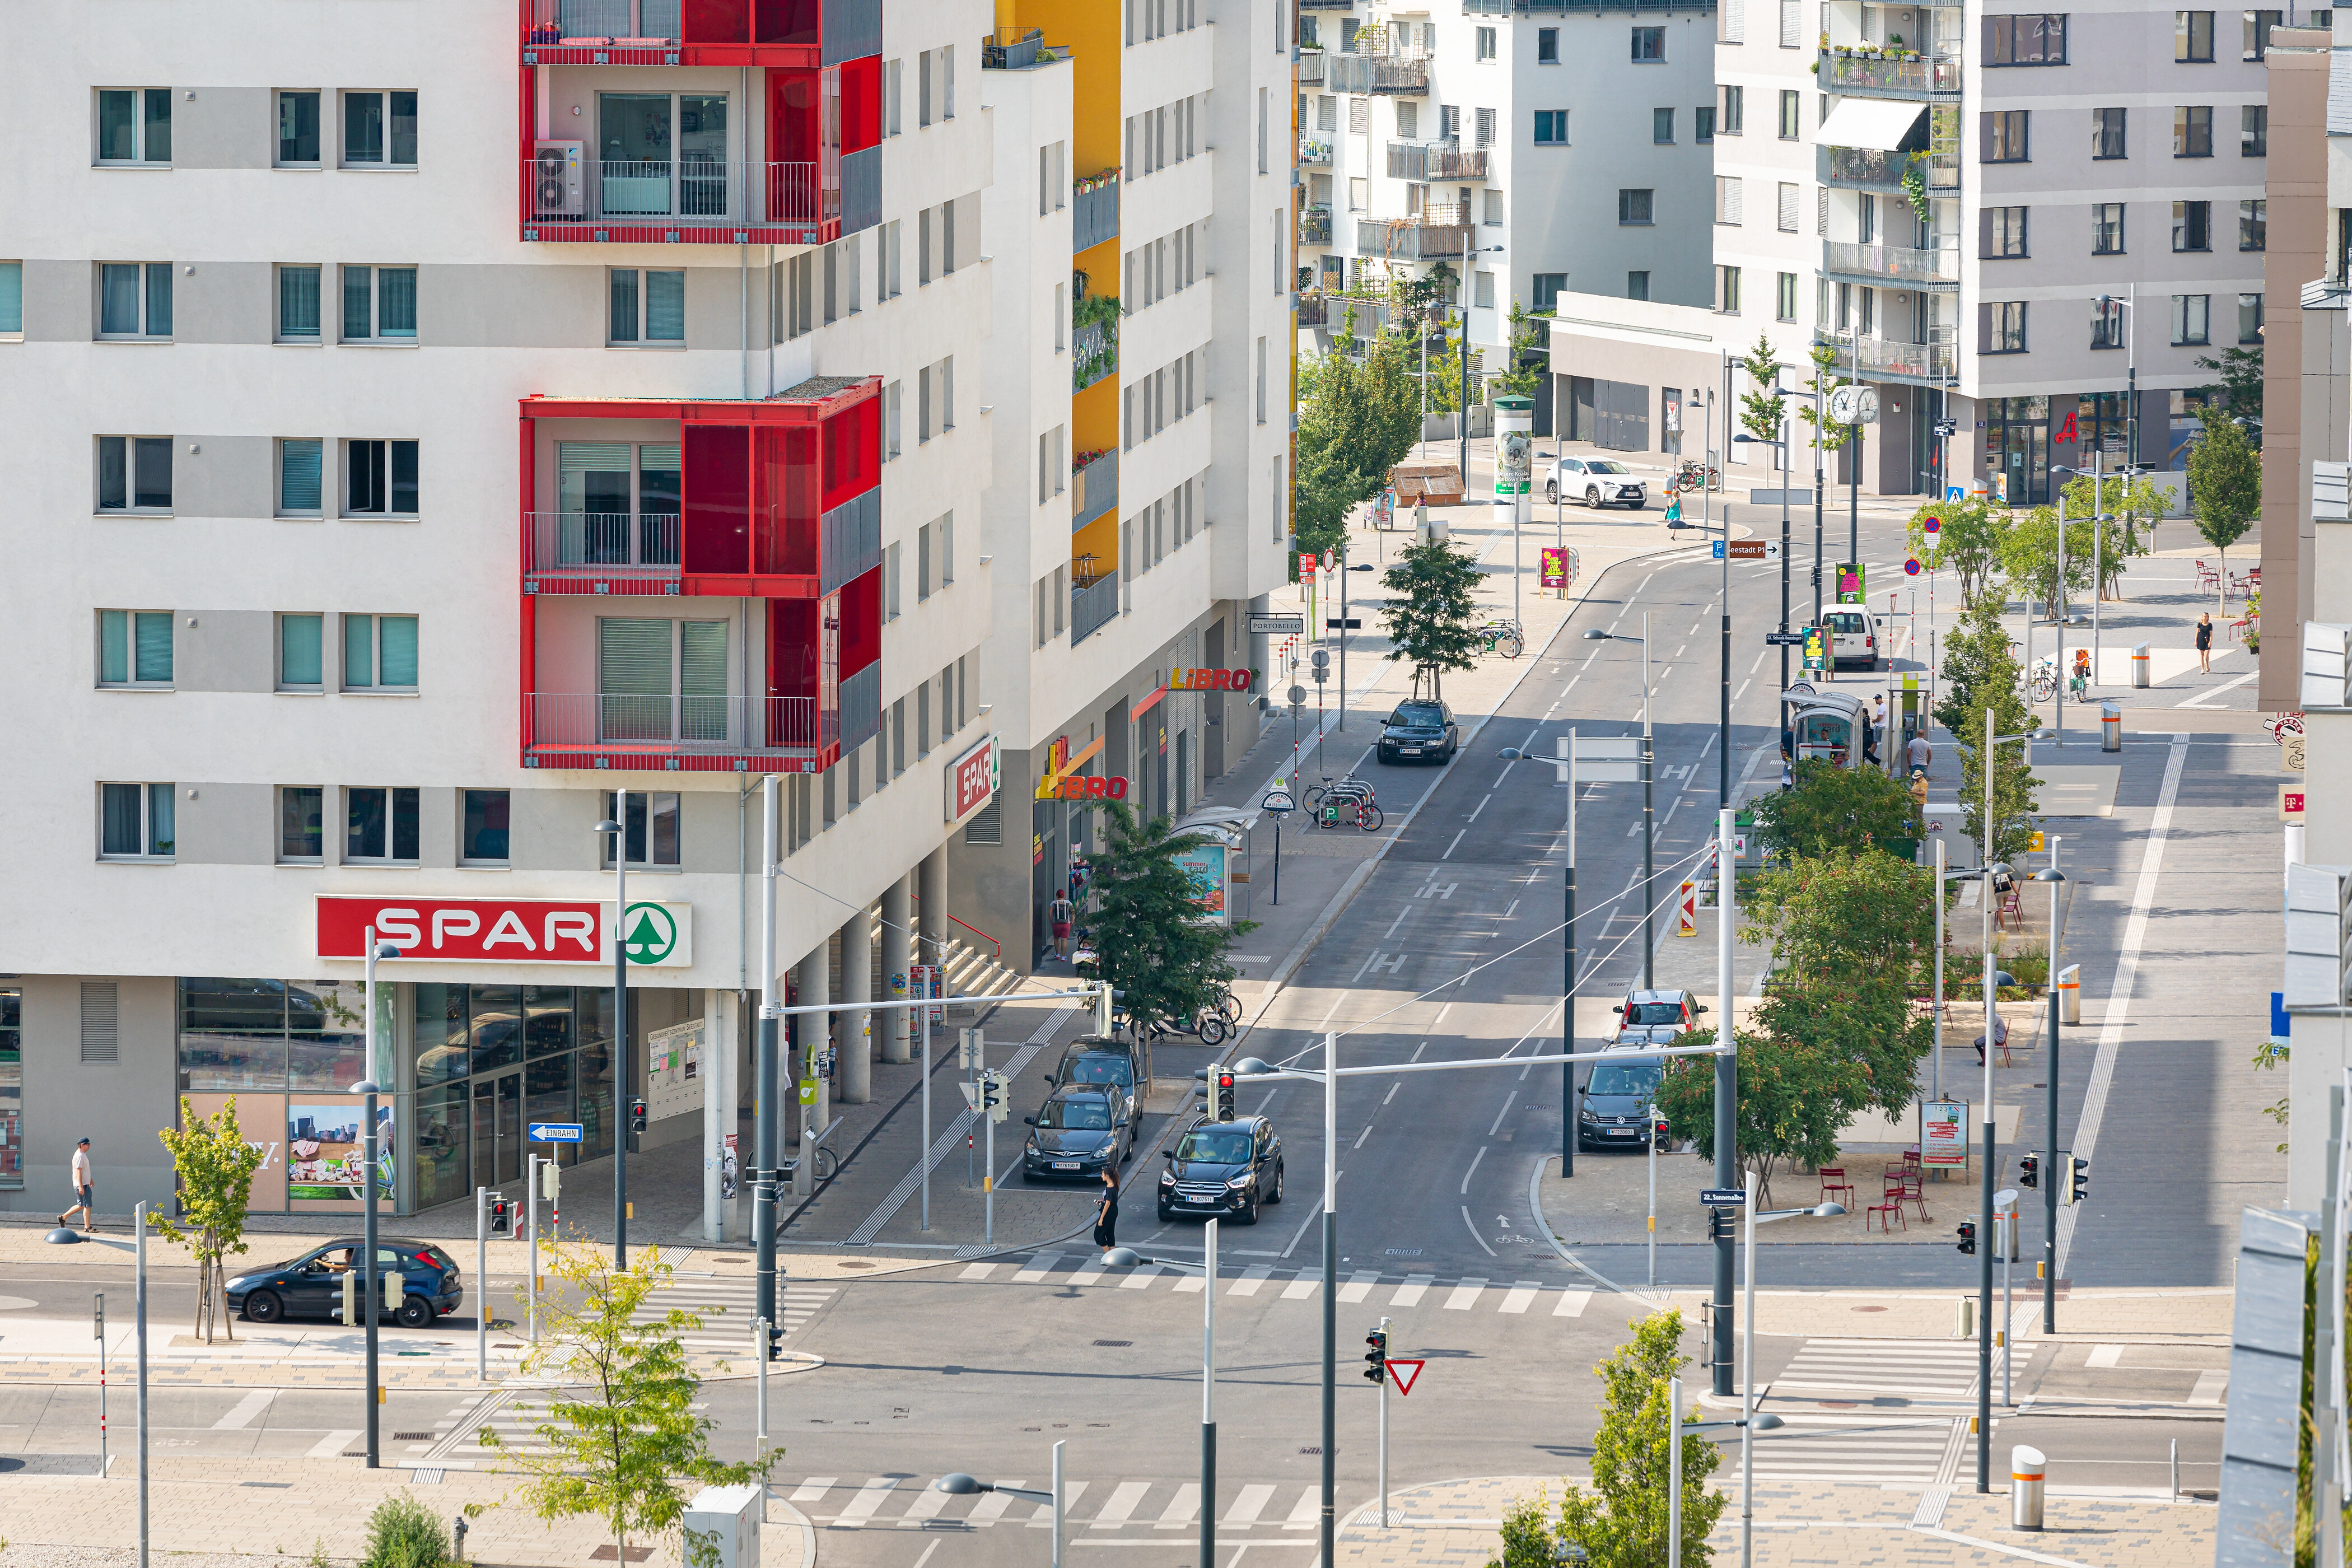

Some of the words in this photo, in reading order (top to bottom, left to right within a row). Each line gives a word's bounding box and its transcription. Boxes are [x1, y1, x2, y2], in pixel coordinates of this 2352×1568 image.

[1696, 477, 1702, 485] P
[1485, 641, 1492, 651] P
[963, 752, 990, 805] SPAR
[1326, 808, 1336, 819] P
[376, 908, 594, 952] SPAR
[687, 1021, 702, 1030] SEESTADT
